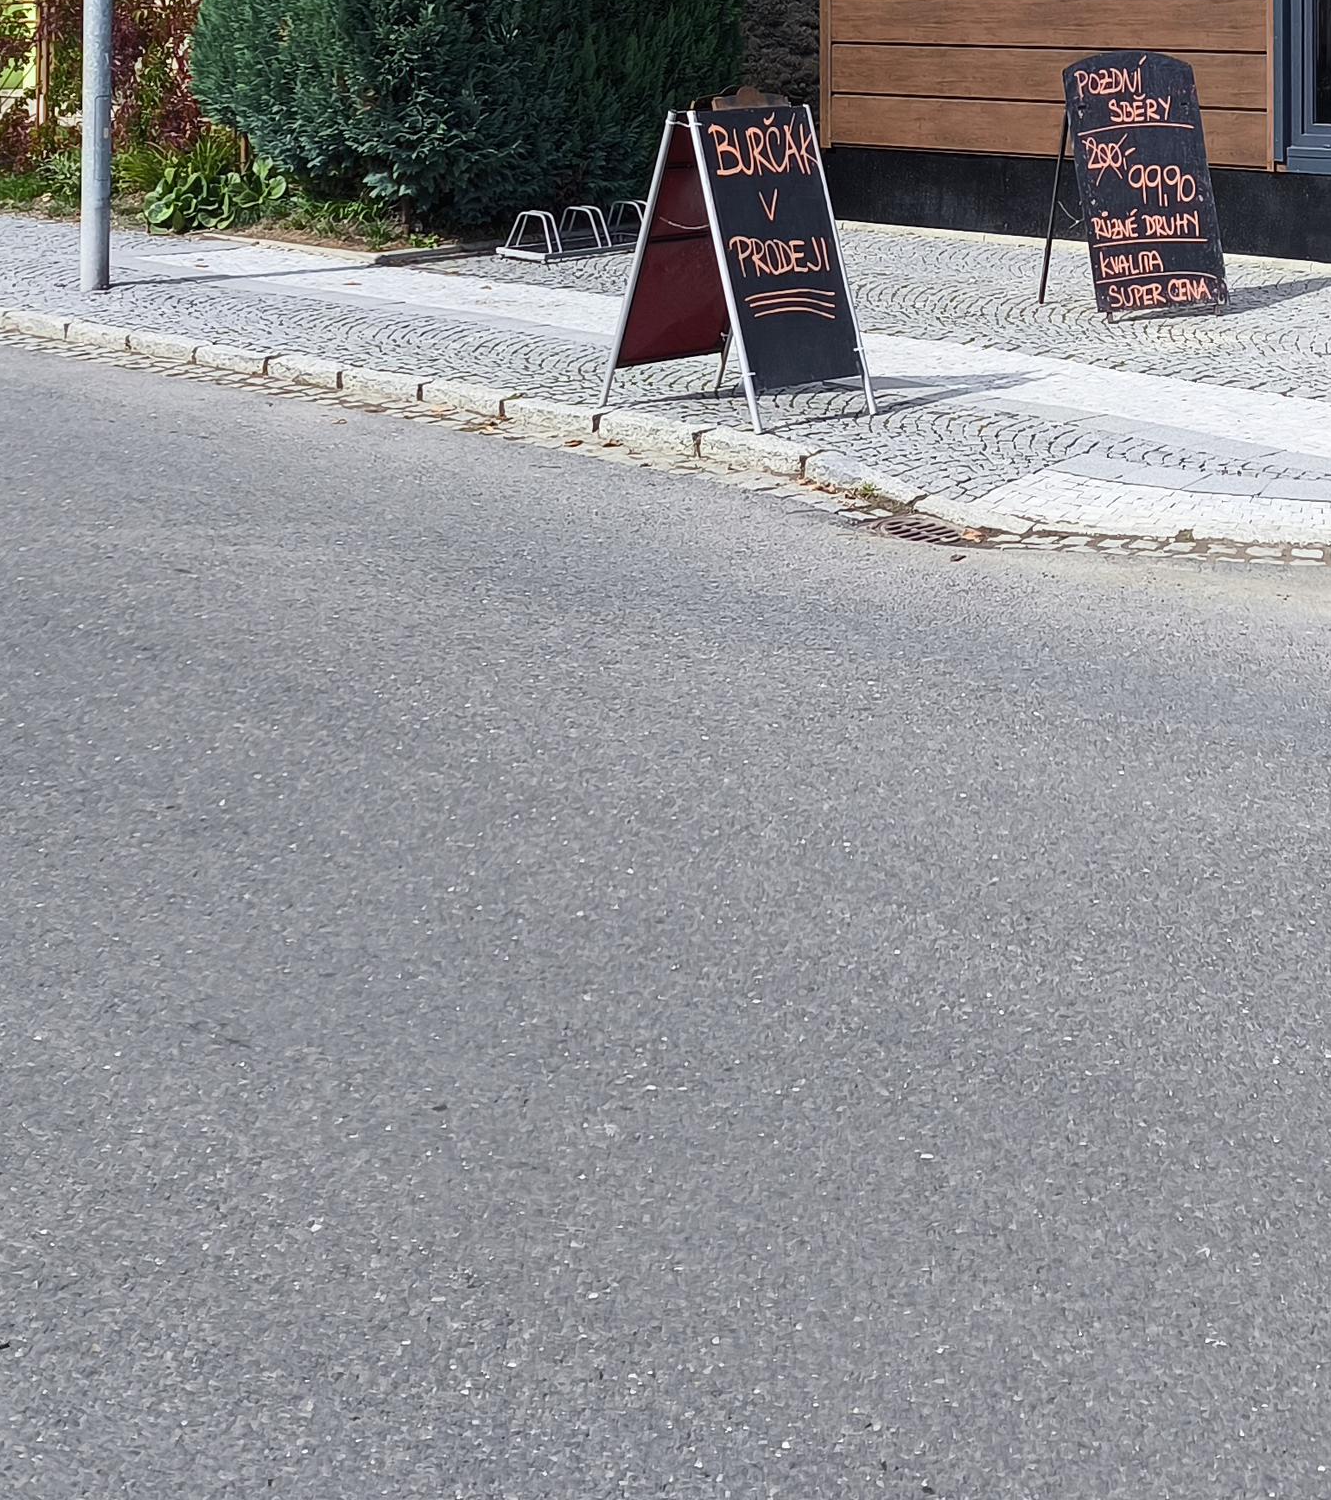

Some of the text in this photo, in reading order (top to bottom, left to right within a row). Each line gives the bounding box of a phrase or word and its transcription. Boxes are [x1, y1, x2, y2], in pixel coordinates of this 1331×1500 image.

[1074, 55, 1146, 99] POZDNÍ
[1108, 94, 1171, 122] SBĚRY
[708, 112, 819, 176] BURČÁK
[759, 188, 778, 222] V
[1128, 165, 1196, 207] 99,90
[1142, 210, 1201, 238] DRUHY
[728, 236, 831, 278] PRODEJI
[1108, 277, 1213, 308] SUPER CENA
